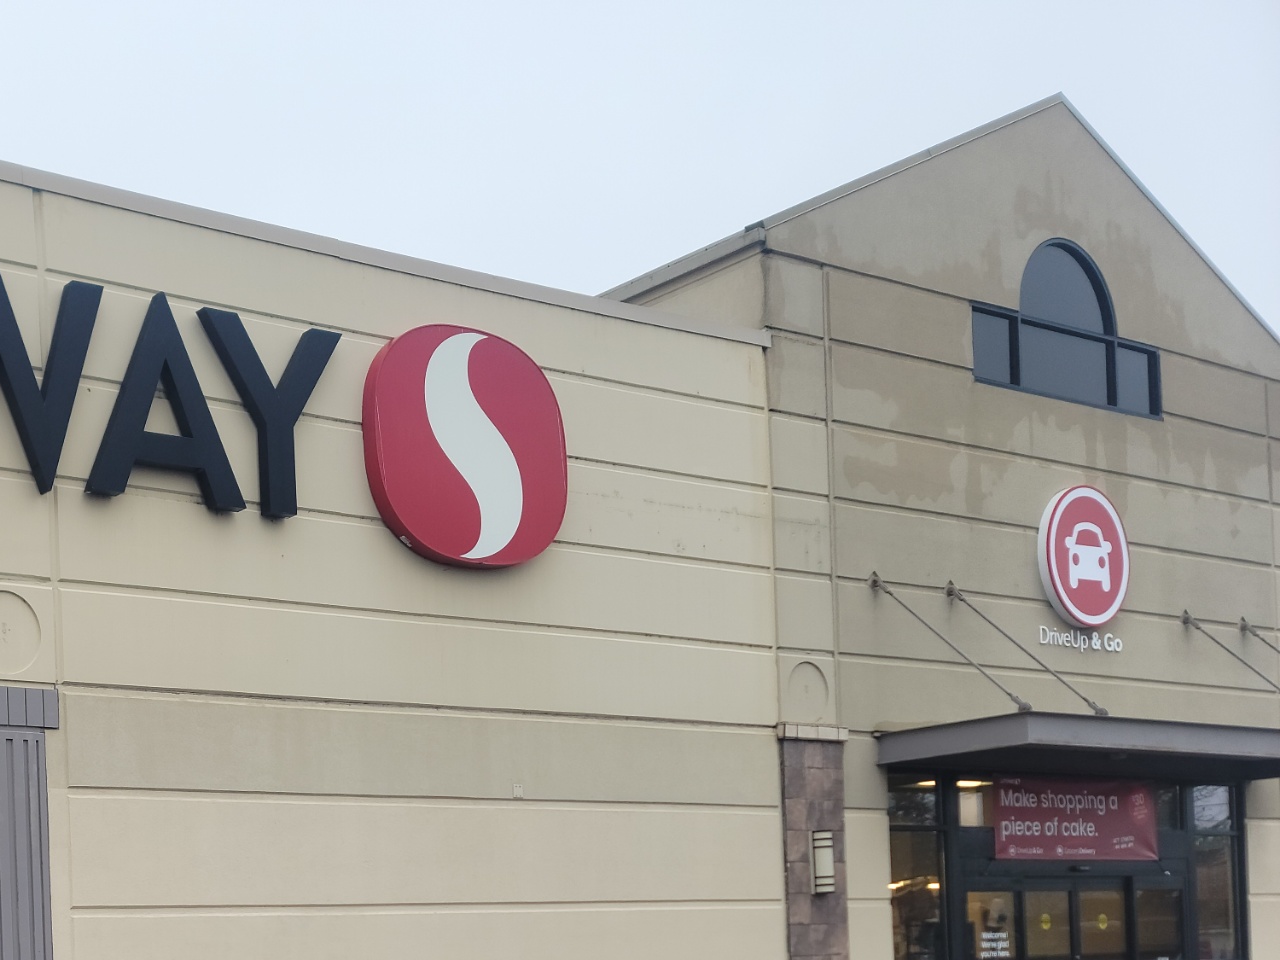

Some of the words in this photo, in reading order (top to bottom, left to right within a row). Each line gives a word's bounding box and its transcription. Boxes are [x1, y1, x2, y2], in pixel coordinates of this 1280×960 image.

[1039, 626, 1088, 652] DriveUp
[1091, 632, 1102, 650] &
[1104, 633, 1123, 652] Go
[1000, 789, 1038, 808] Make
[1041, 790, 1106, 816] shopping
[1109, 796, 1119, 810] a
[1001, 816, 1041, 842] piece
[1045, 817, 1059, 836] of
[1062, 818, 1099, 837] cake.
